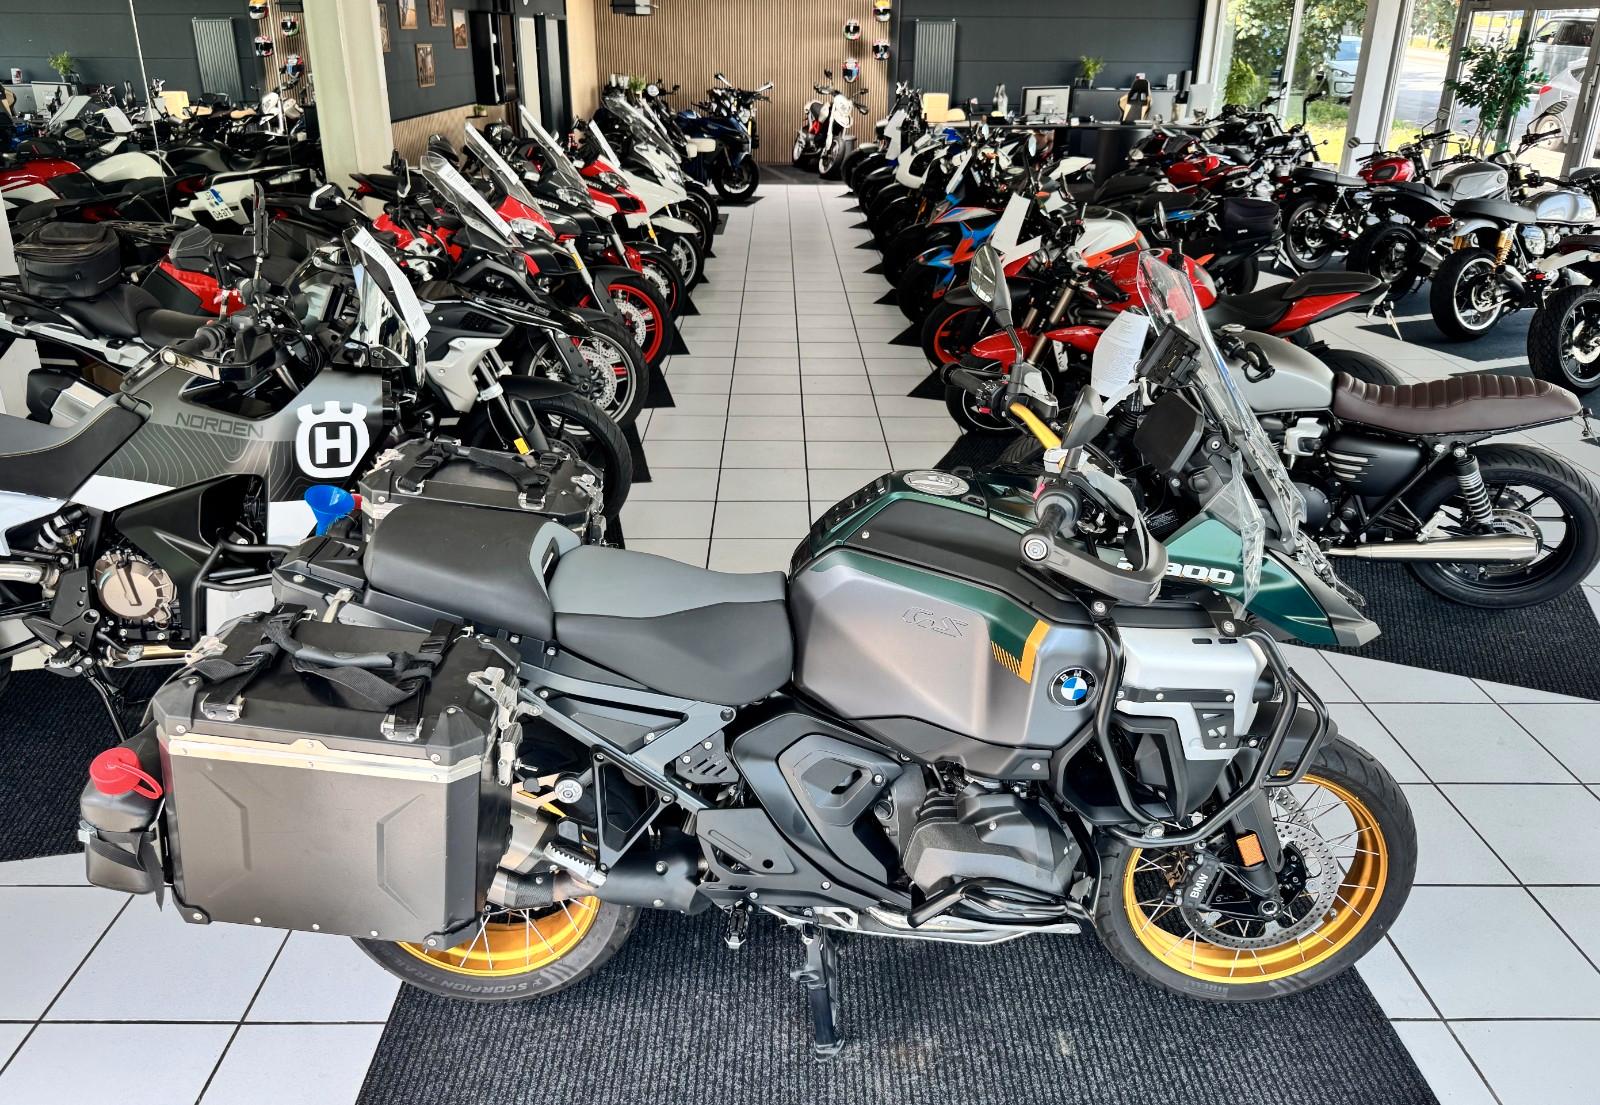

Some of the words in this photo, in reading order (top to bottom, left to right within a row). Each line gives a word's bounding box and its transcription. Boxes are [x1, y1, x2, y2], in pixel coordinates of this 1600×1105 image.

[175, 411, 264, 439] NORDEN
[1190, 873, 1209, 899] BMW
[440, 980, 528, 994] SCORPION
